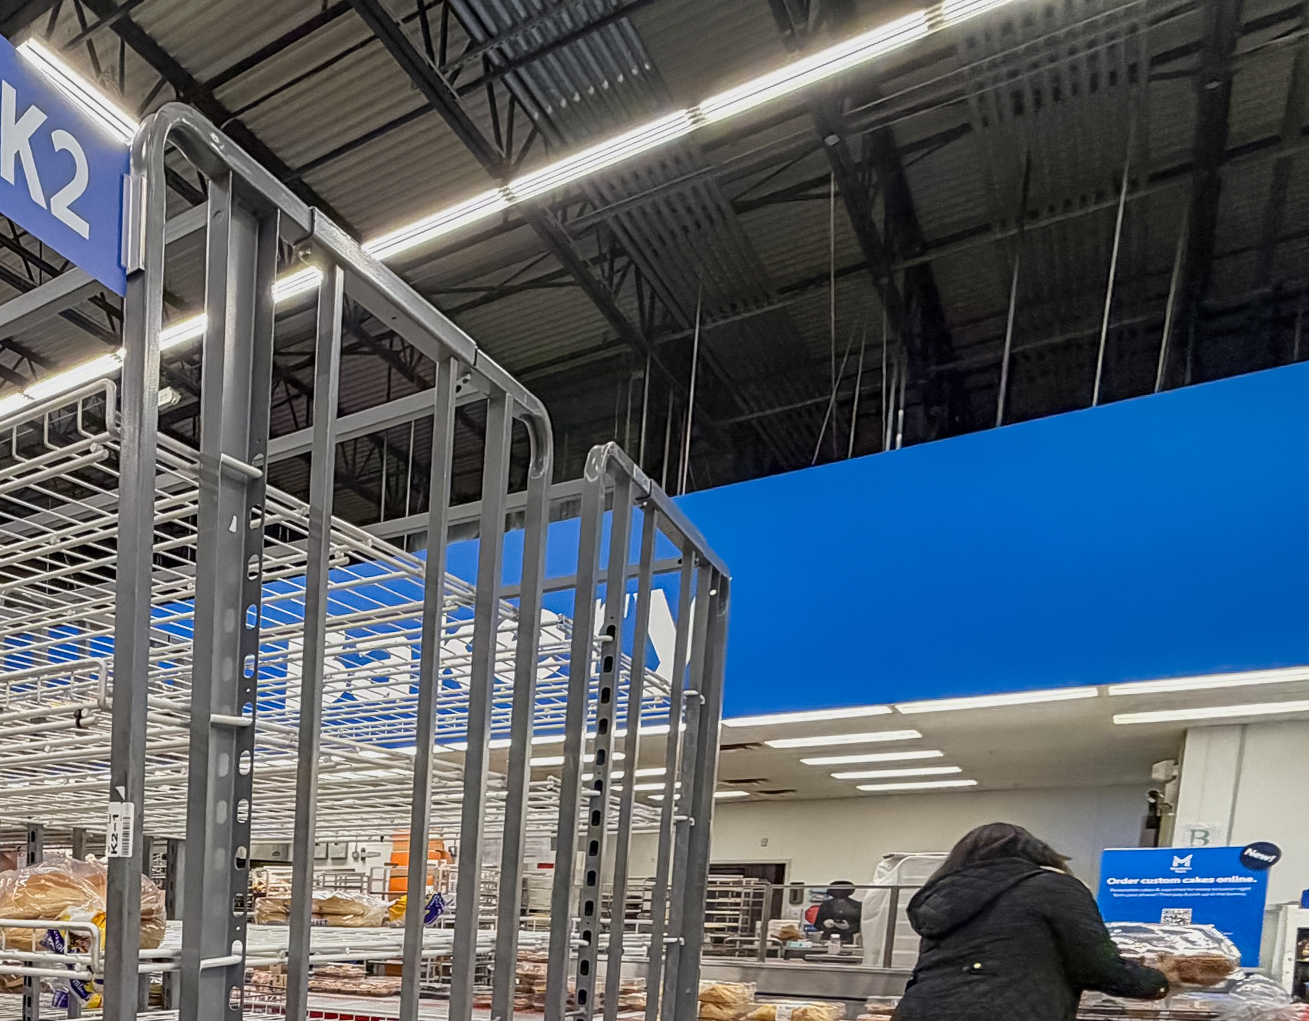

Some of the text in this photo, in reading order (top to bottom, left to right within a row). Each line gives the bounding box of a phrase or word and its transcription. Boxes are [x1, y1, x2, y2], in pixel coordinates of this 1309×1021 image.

[0, 79, 90, 240] K2
[1243, 848, 1276, 863] New!
[1106, 875, 1258, 886] Order custom cakes online.
